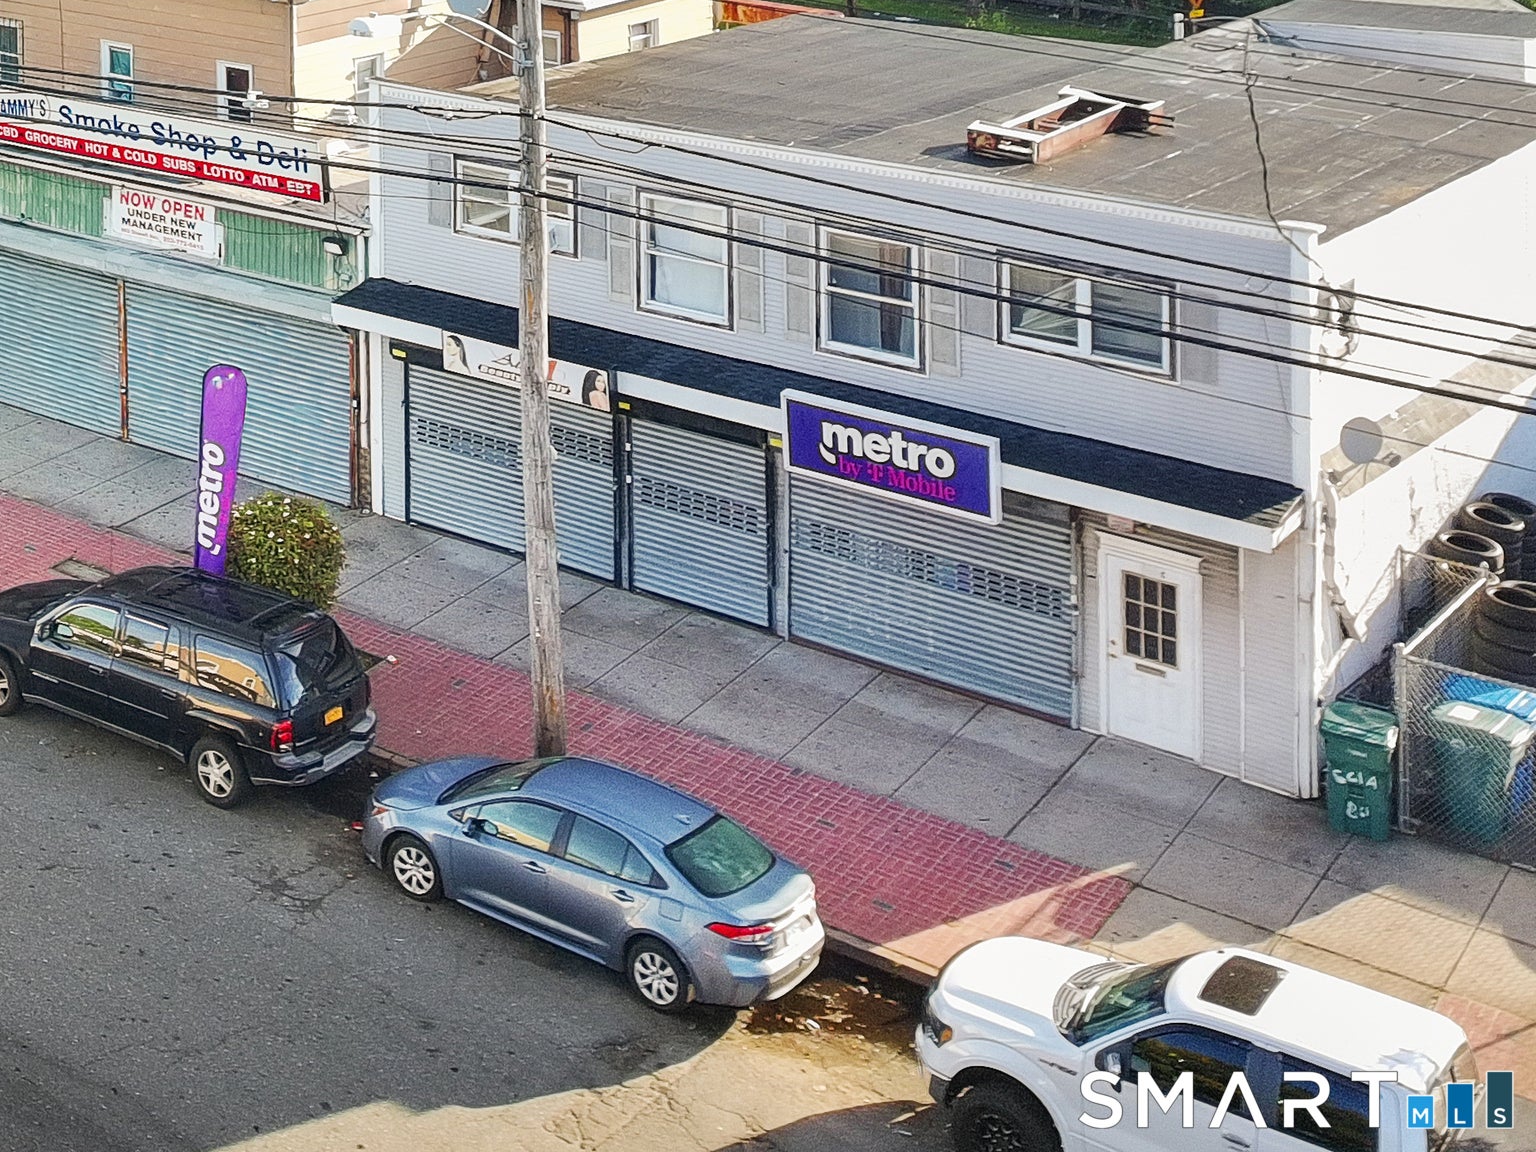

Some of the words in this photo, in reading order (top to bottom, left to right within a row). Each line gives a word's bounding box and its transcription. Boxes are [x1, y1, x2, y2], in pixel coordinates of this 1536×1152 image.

[59, 105, 141, 140] Smoke
[151, 121, 216, 160] Shop
[230, 136, 247, 161] &
[257, 140, 308, 174] Deli
[25, 131, 78, 150] GROCERY
[85, 142, 109, 157] HOT
[112, 147, 121, 159] &
[123, 148, 157, 165] COLD
[162, 158, 197, 173] SUBS
[203, 164, 245, 182] LOTTO
[252, 173, 279, 188] ATM
[286, 181, 313, 196] EBT
[120, 191, 156, 210] NOW
[161, 199, 204, 221] OPEN
[127, 208, 166, 224] UNDER
[170, 217, 196, 230] NEW
[121, 217, 203, 242] MANAGEMENT
[820, 421, 955, 479] metro
[838, 455, 862, 480] by
[197, 441, 225, 555] metro
